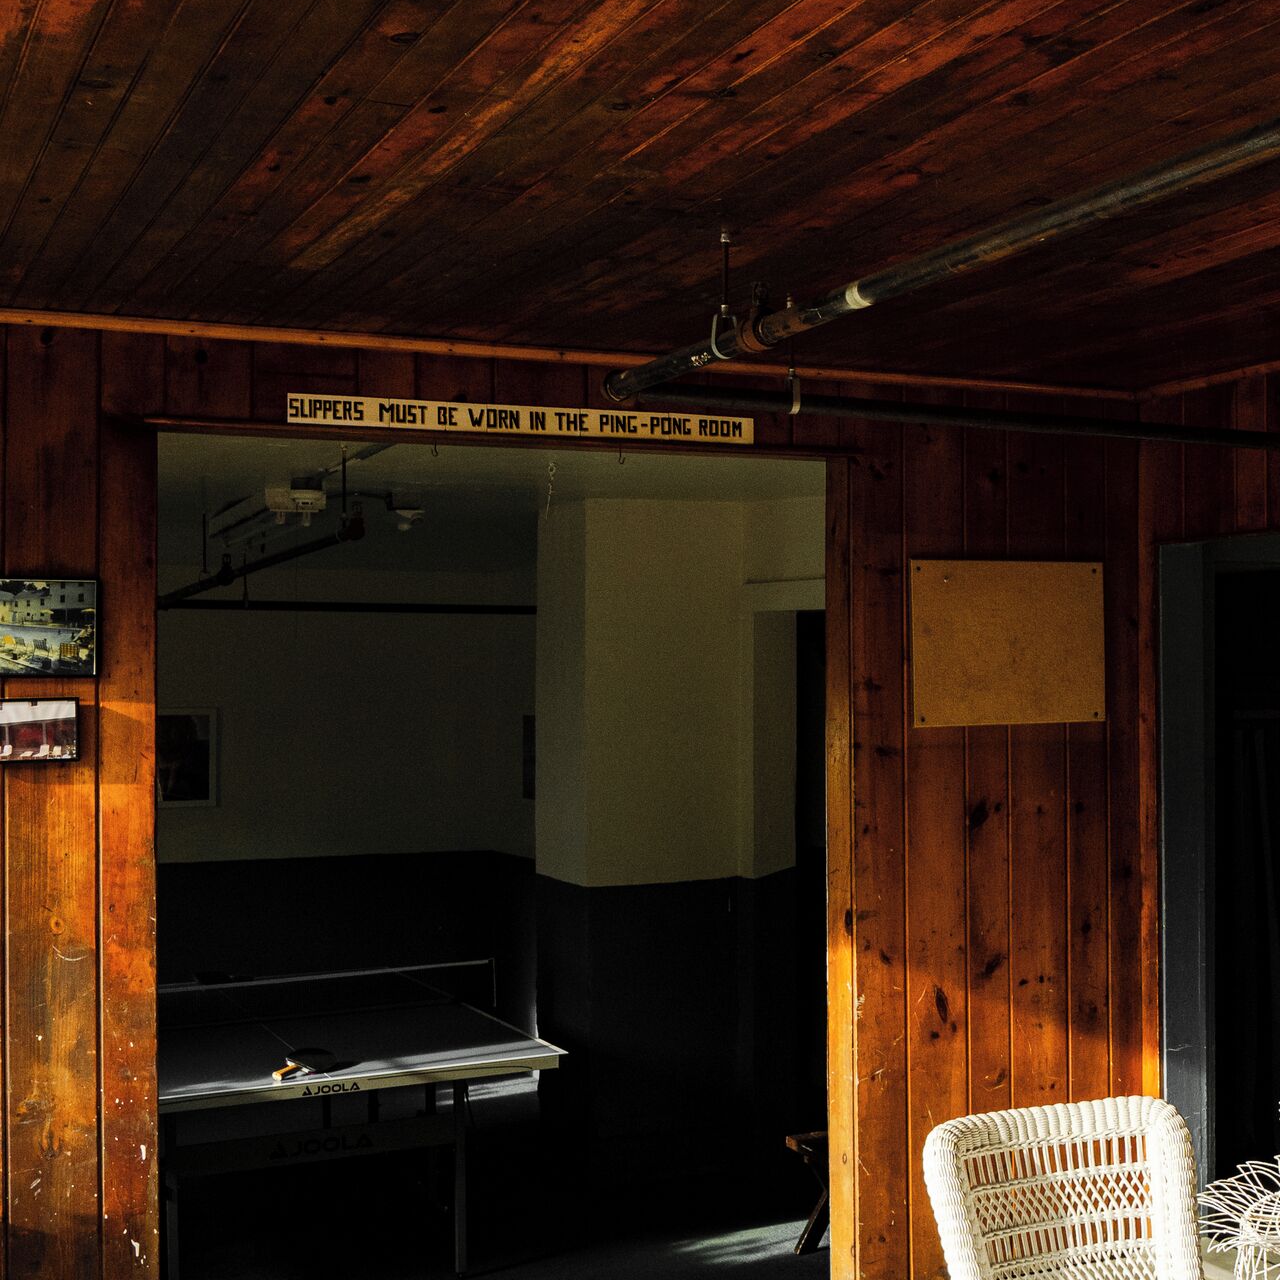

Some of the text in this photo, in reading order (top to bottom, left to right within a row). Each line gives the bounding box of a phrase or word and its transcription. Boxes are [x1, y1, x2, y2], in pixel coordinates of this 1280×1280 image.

[289, 398, 743, 437] SLIPPERS MUST BE WORN IN THE PING-PONG ROOM
[314, 1082, 360, 1095] JOOLA
